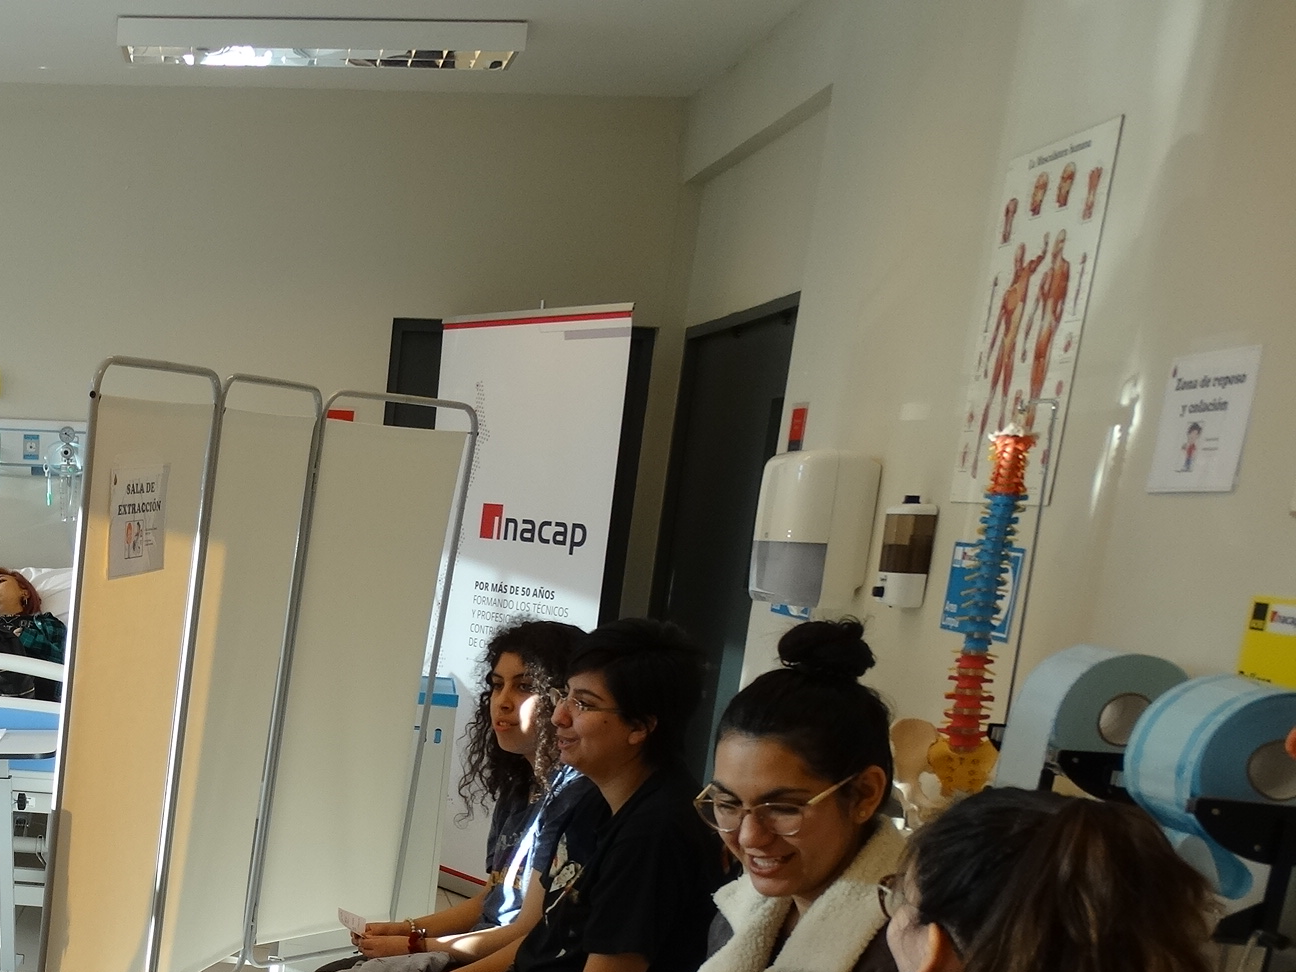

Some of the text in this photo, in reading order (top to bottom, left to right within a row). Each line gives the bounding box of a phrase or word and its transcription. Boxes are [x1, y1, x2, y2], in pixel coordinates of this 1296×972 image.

[1199, 375, 1211, 389] de
[1212, 374, 1247, 390] reposo
[126, 481, 156, 496] SALA DE
[117, 499, 162, 516] EXTRACCIÓN
[474, 580, 555, 600] POR MÁS DE 50 AÑOS
[471, 609, 477, 618] Y
[472, 594, 569, 618] FORMANDO LOS TÉCNICOS
[468, 637, 478, 648] DE
